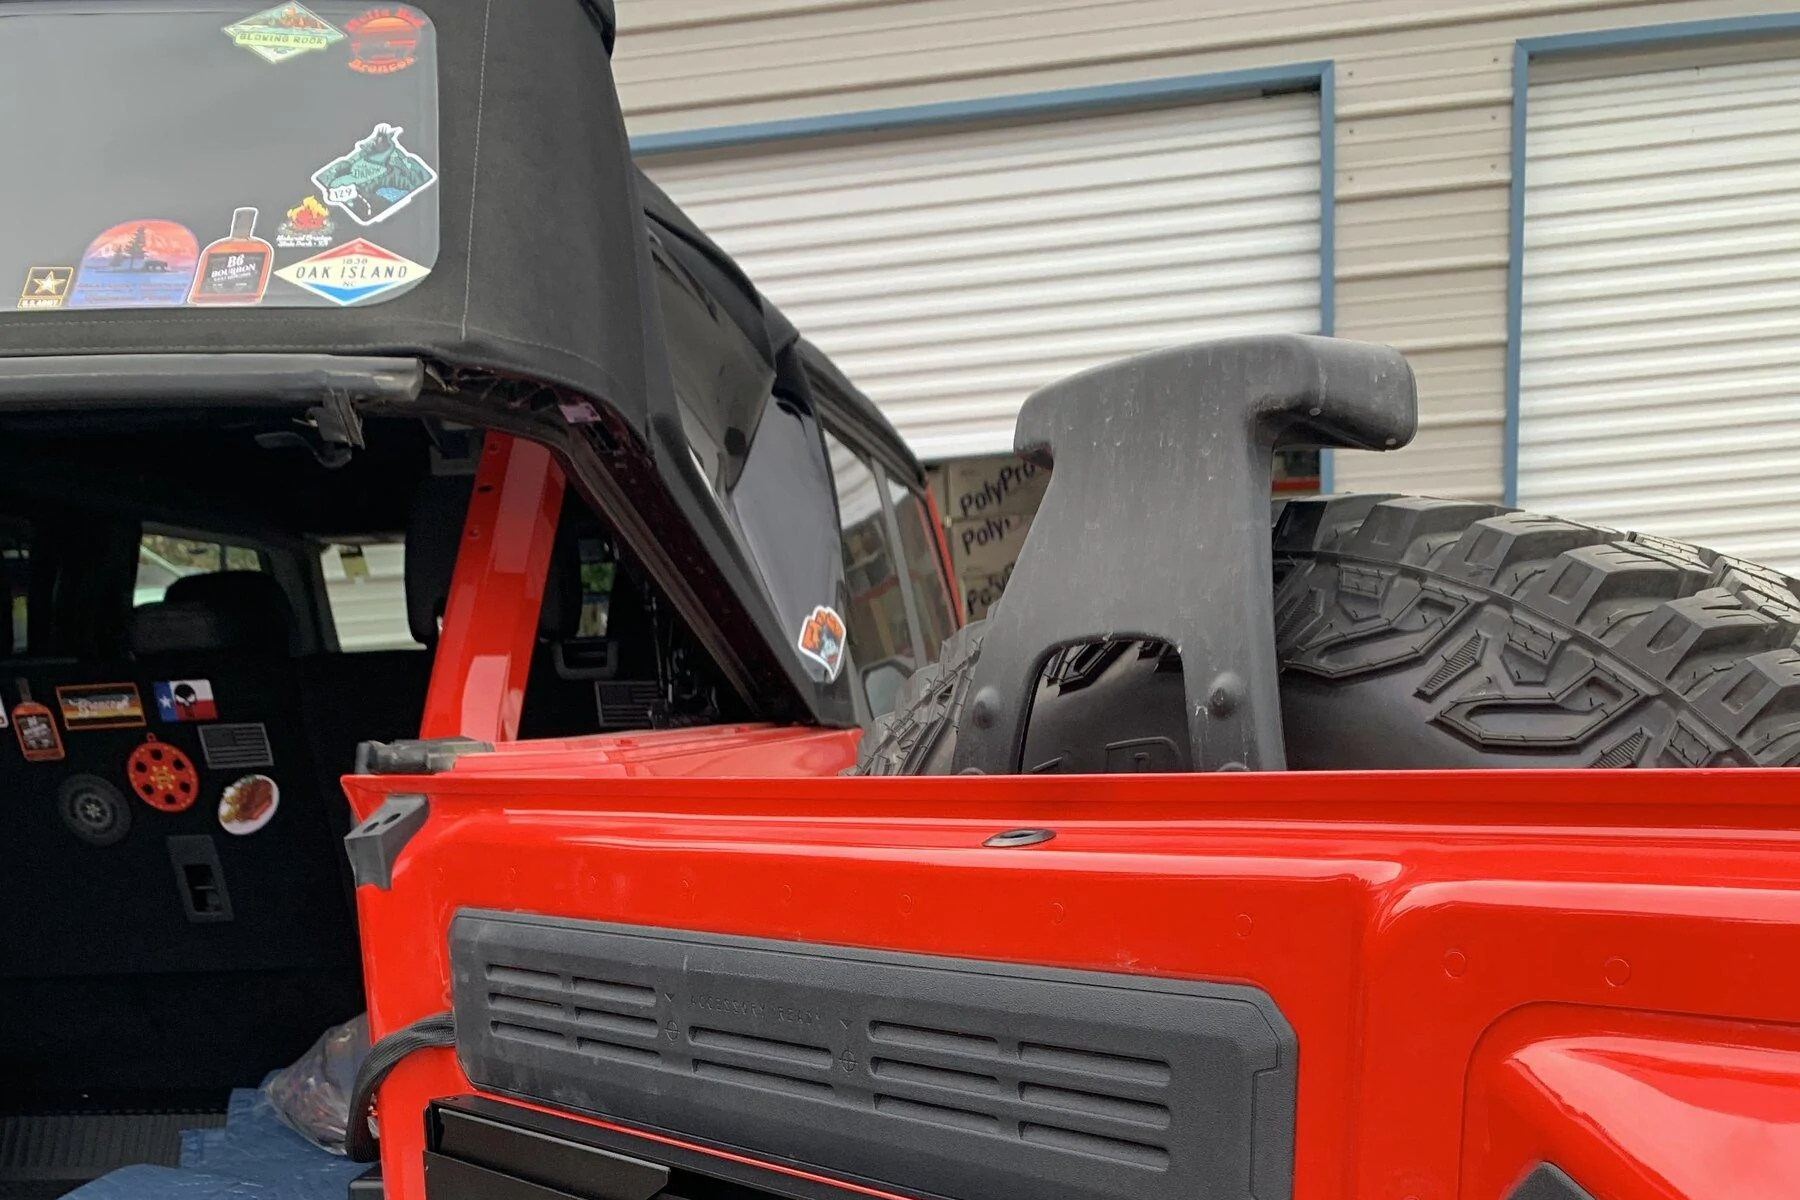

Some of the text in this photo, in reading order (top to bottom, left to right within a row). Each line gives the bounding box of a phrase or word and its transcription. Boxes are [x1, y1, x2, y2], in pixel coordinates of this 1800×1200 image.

[333, 187, 353, 199] 129
[295, 265, 407, 279] OAK ISLAND
